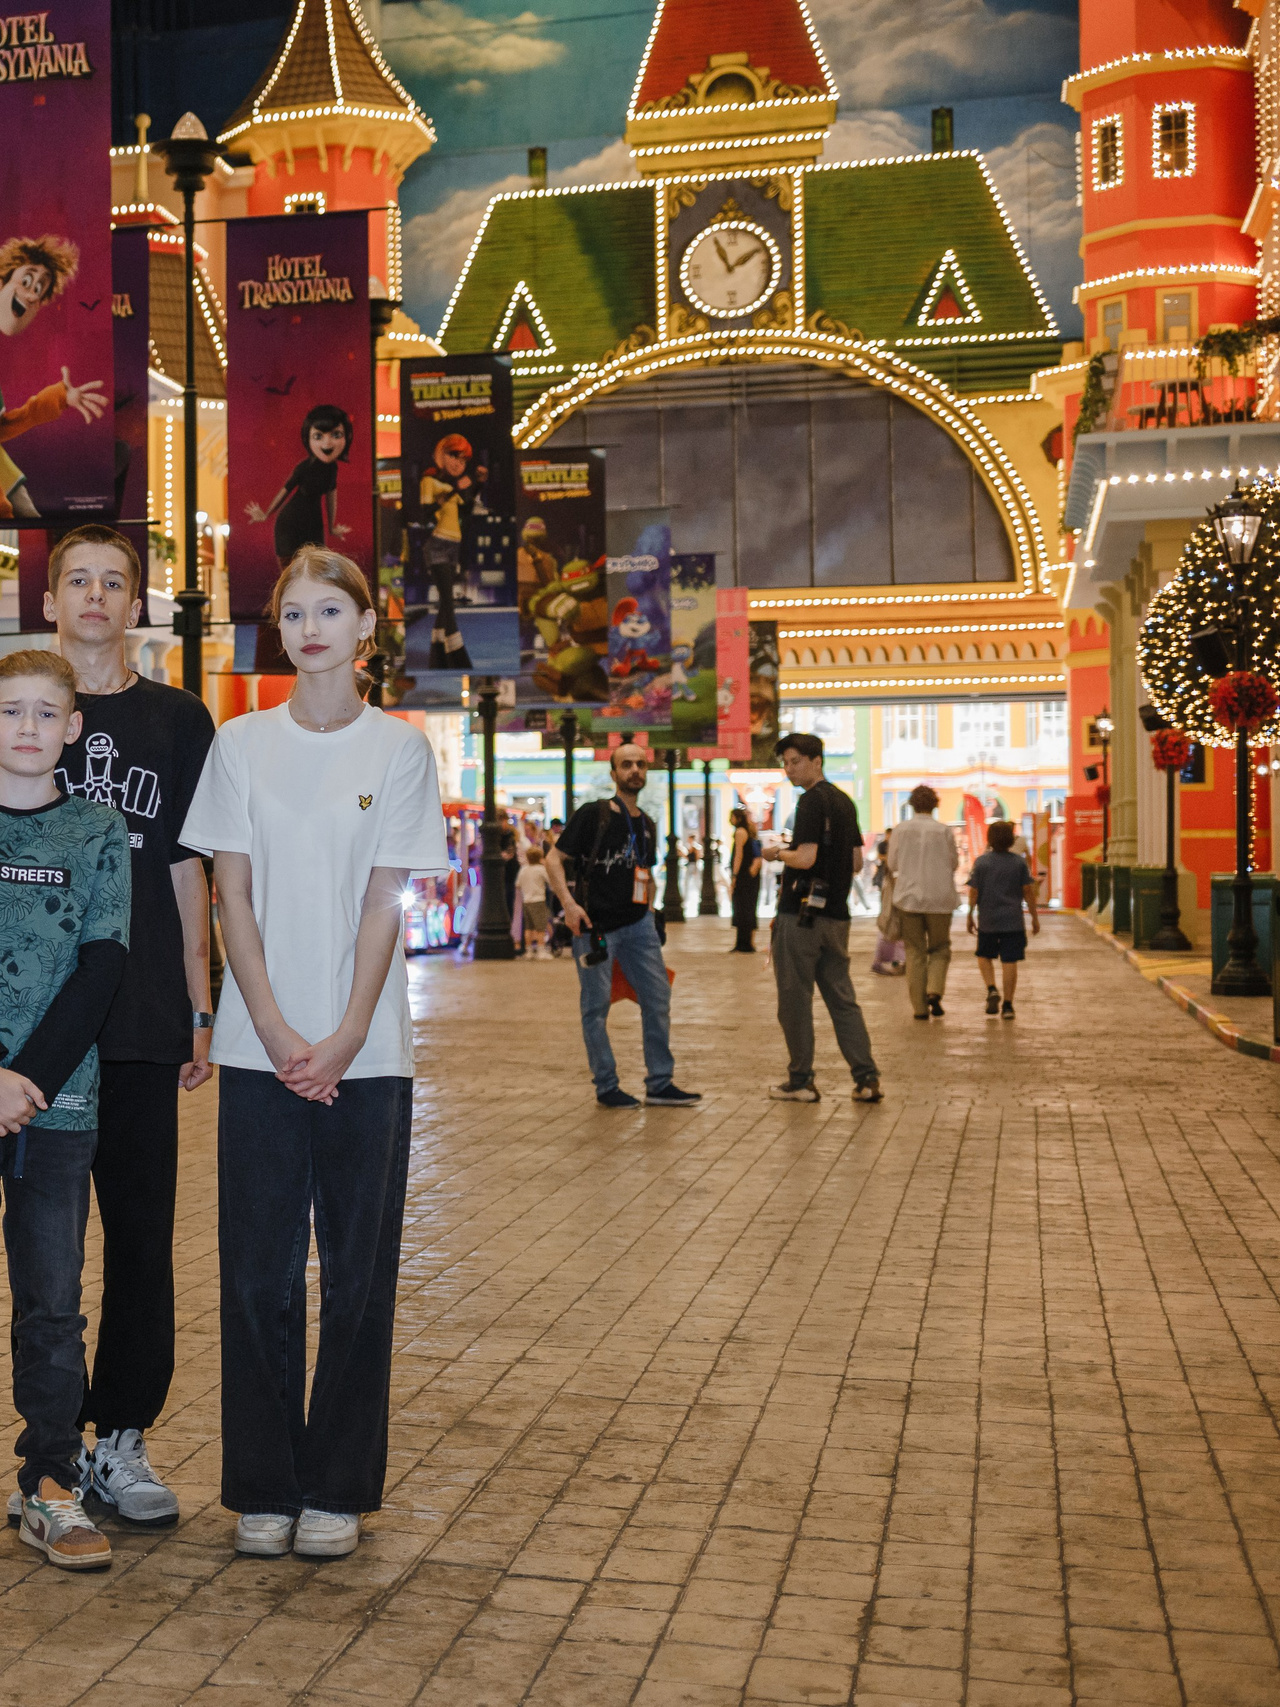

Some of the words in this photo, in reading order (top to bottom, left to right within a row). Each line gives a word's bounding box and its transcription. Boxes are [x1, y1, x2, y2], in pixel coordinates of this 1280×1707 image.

[267, 254, 327, 282] HOTEL
[238, 276, 354, 309] TRANSYLVANIA
[411, 381, 492, 401] TURTLES
[0, 866, 64, 884] STREETS
